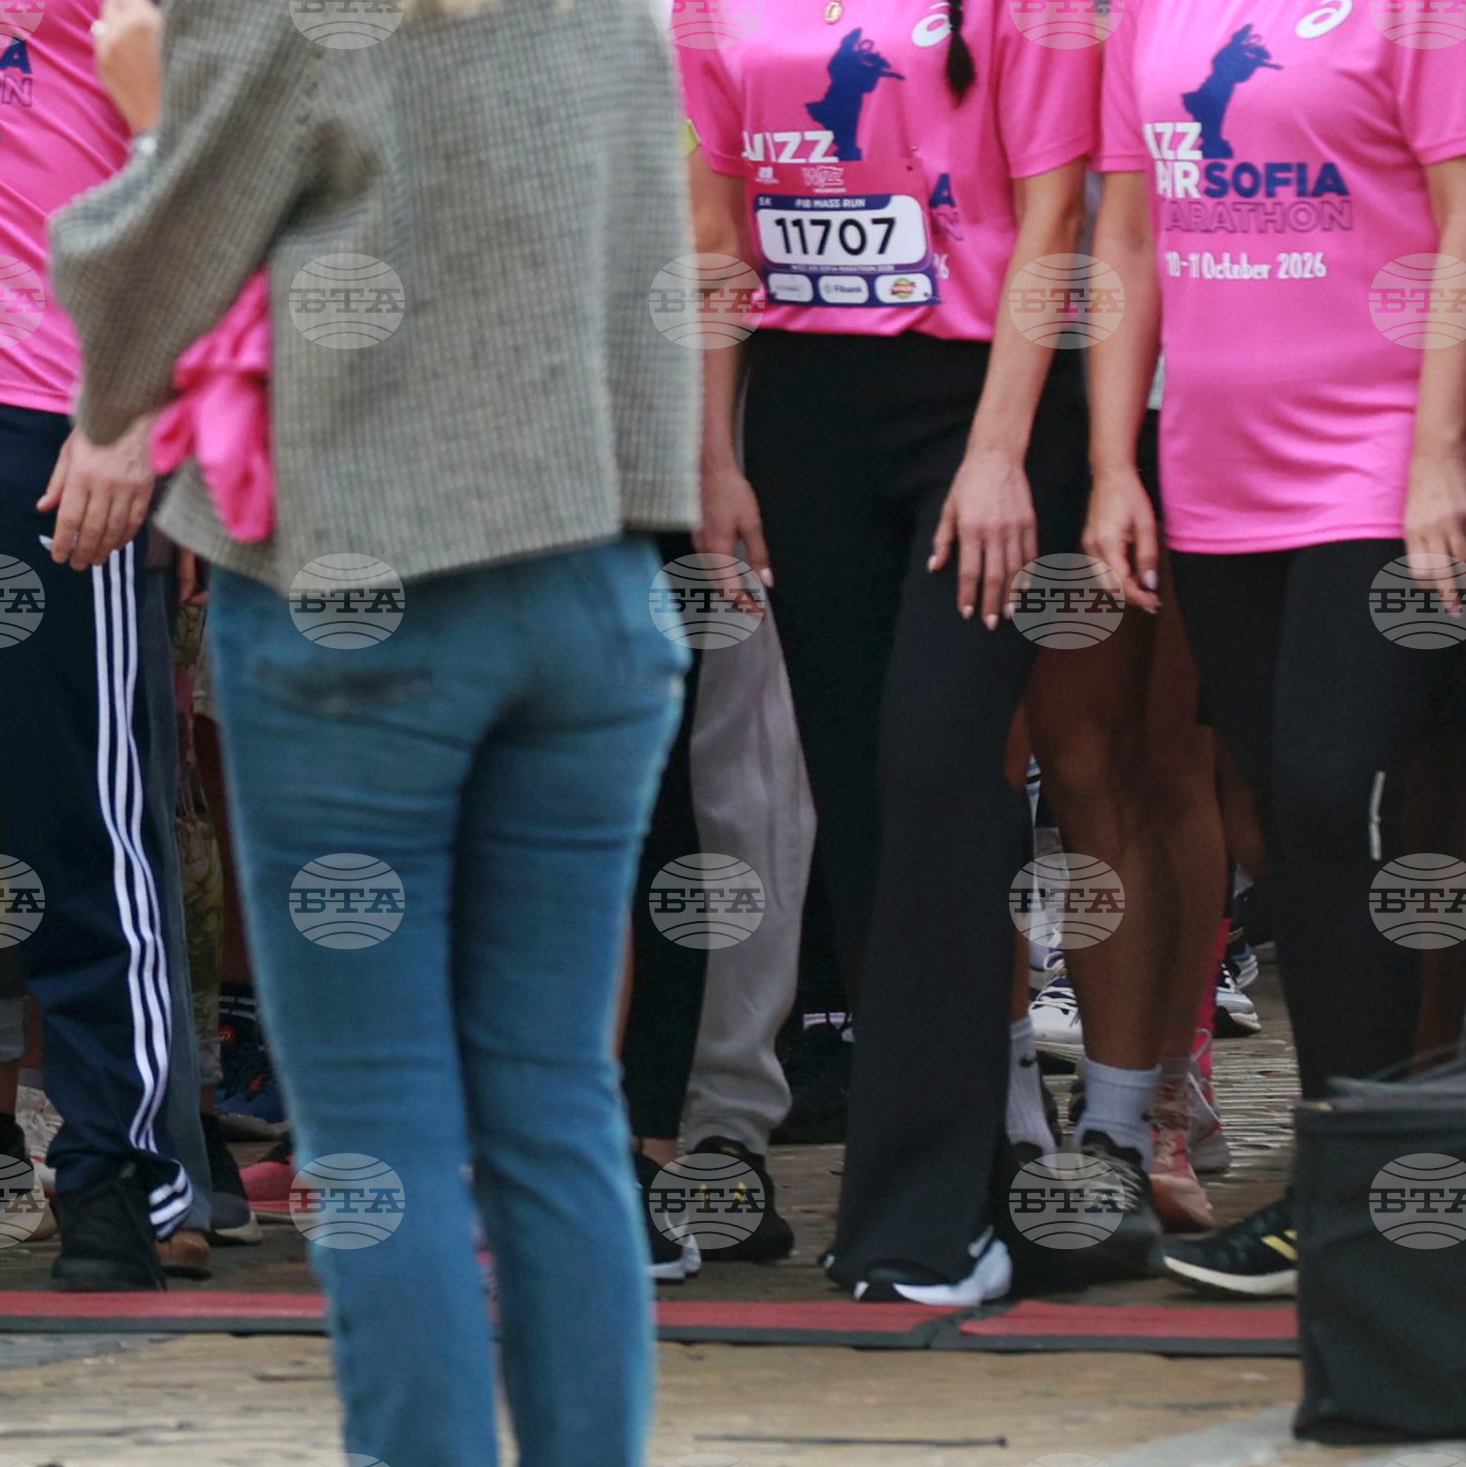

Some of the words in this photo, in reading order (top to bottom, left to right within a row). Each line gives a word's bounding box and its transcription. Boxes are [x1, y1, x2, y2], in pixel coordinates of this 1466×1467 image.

[1143, 121, 1203, 161] IZZ
[1205, 161, 1351, 199] SOFIA
[794, 198, 812, 209] FIB
[813, 198, 842, 209] MASS
[842, 198, 866, 209] RUN
[1165, 200, 1354, 234] ARATHON
[775, 217, 897, 256] 11707
[1201, 252, 1272, 279] October
[1276, 252, 1327, 279] 2026
[834, 282, 863, 294] Fibank
